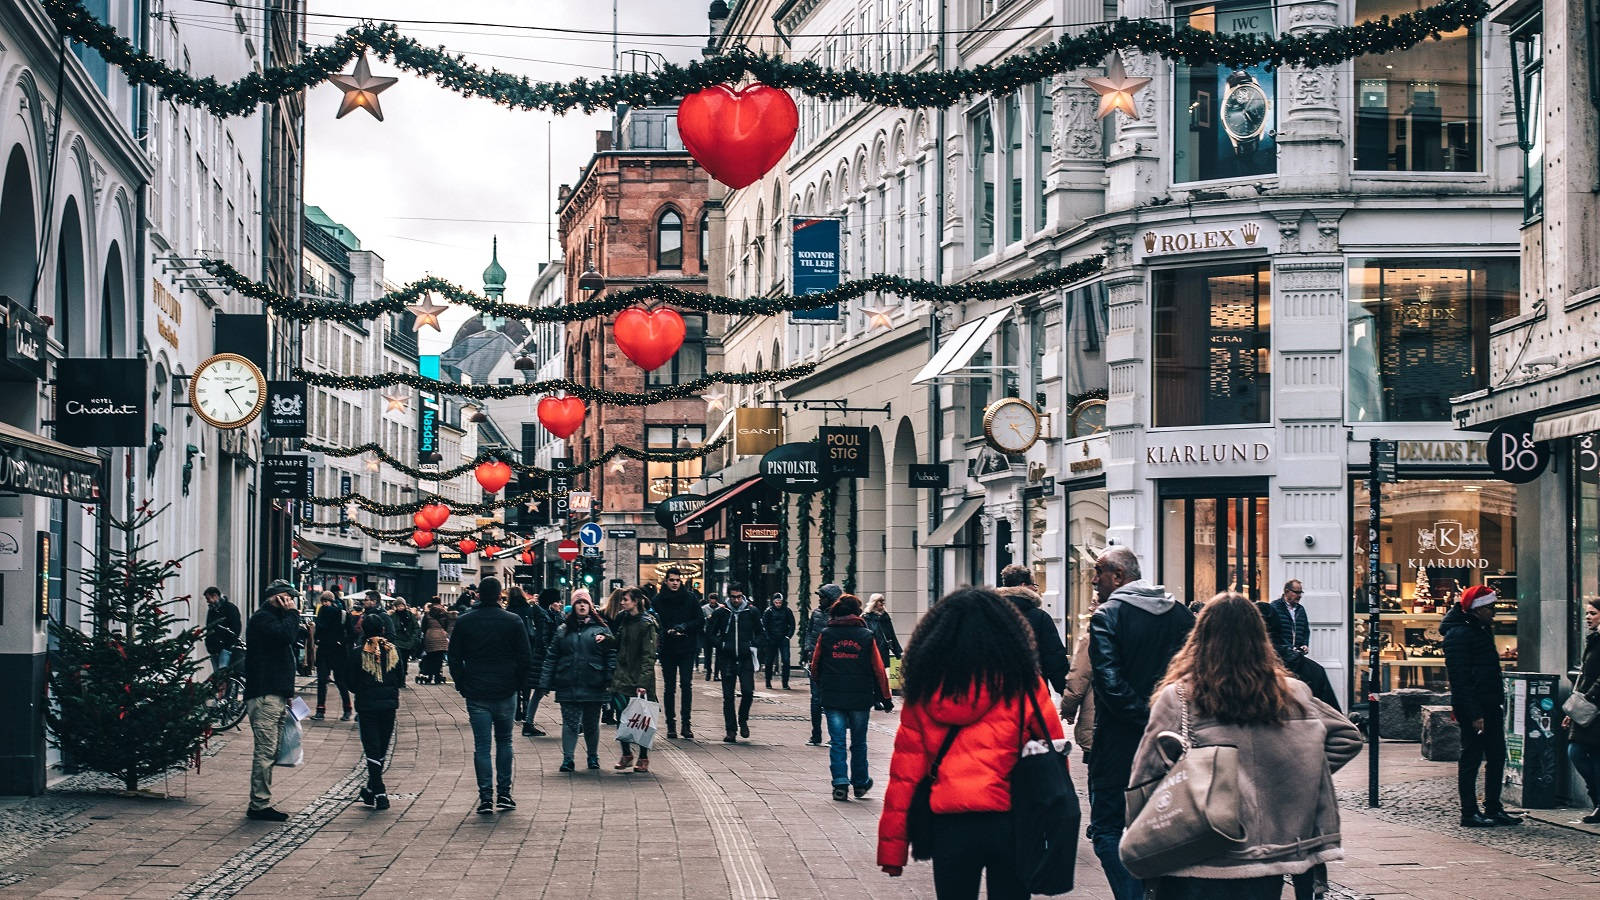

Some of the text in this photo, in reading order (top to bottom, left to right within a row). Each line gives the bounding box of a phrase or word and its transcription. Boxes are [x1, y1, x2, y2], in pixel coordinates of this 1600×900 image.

[1232, 16, 1259, 32] IWC
[1161, 229, 1236, 252] ROLEX
[798, 251, 835, 260] KONTOR
[815, 260, 835, 268] LEJE
[421, 410, 435, 451] Nasdaq
[826, 433, 861, 446] POUL
[829, 448, 858, 460] STIG
[1146, 443, 1269, 463] KLARLUND
[268, 459, 303, 467] STAMPE
[767, 460, 819, 475] PISTOLSTR.
[745, 528, 778, 538] Stenstrup
[1440, 528, 1457, 547] K
[1408, 558, 1489, 569] KLARLUND
[627, 713, 652, 733] H&M
